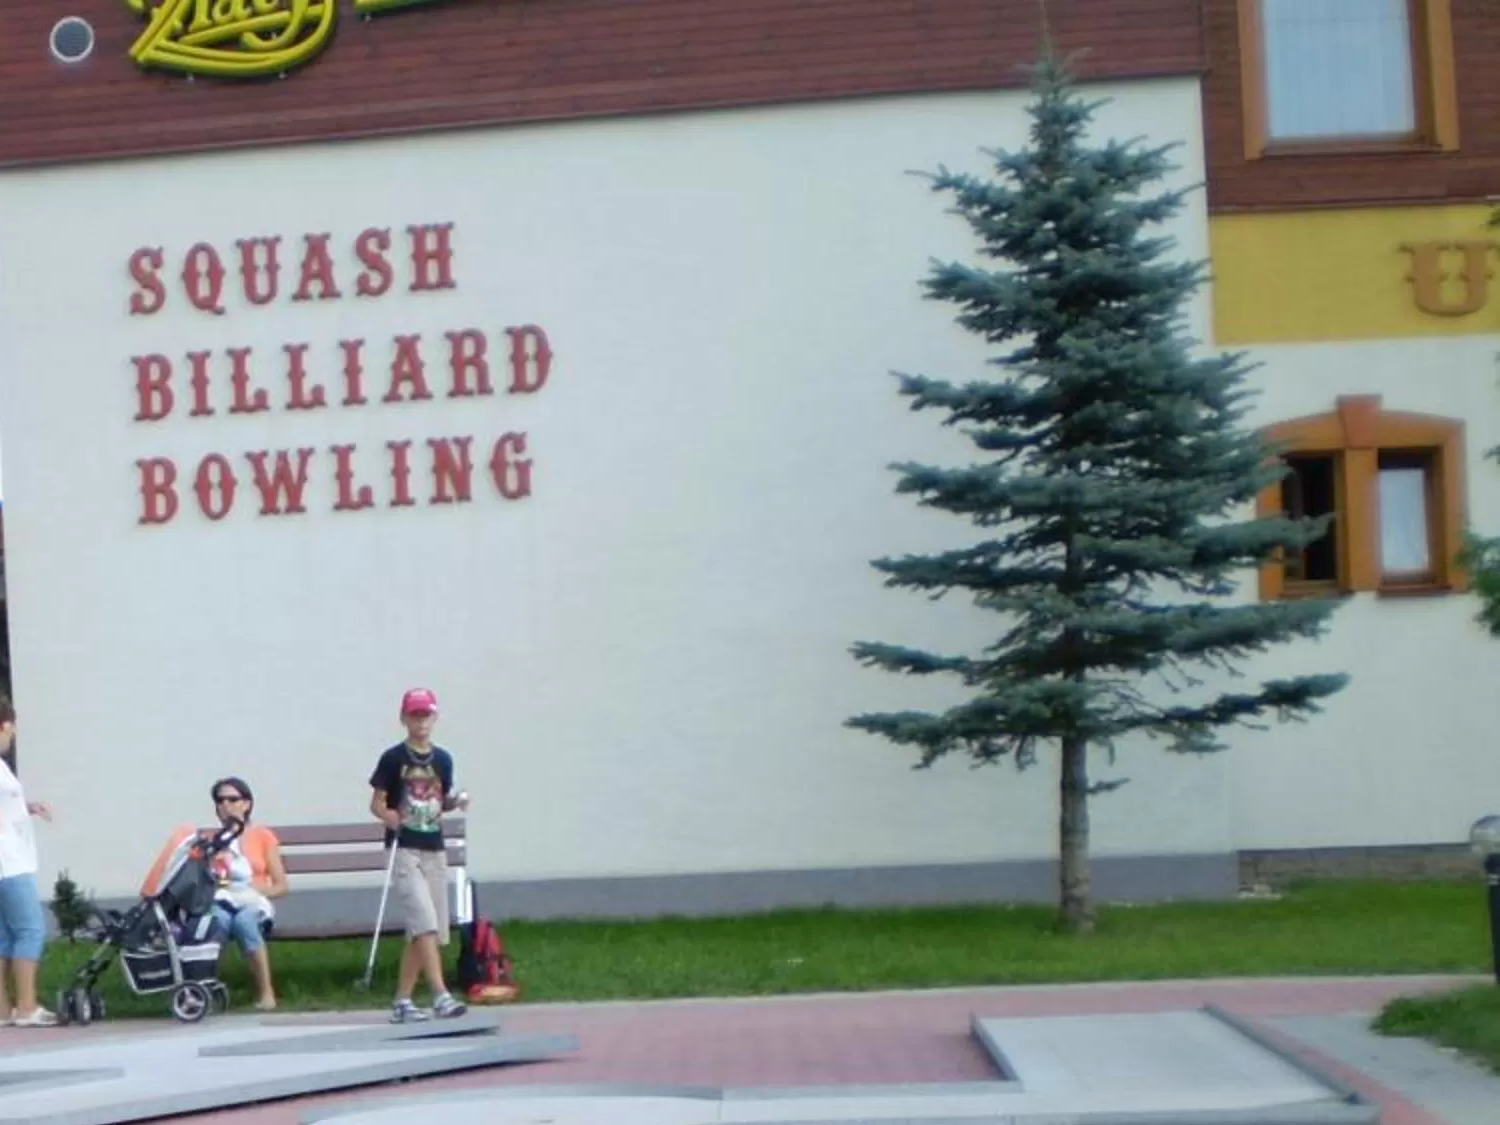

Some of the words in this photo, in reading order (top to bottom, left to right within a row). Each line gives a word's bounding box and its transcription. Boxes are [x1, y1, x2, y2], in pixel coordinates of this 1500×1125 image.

[129, 223, 457, 316] SQUASH
[131, 325, 553, 422] BILLIARD
[136, 432, 533, 525] BOWLING
